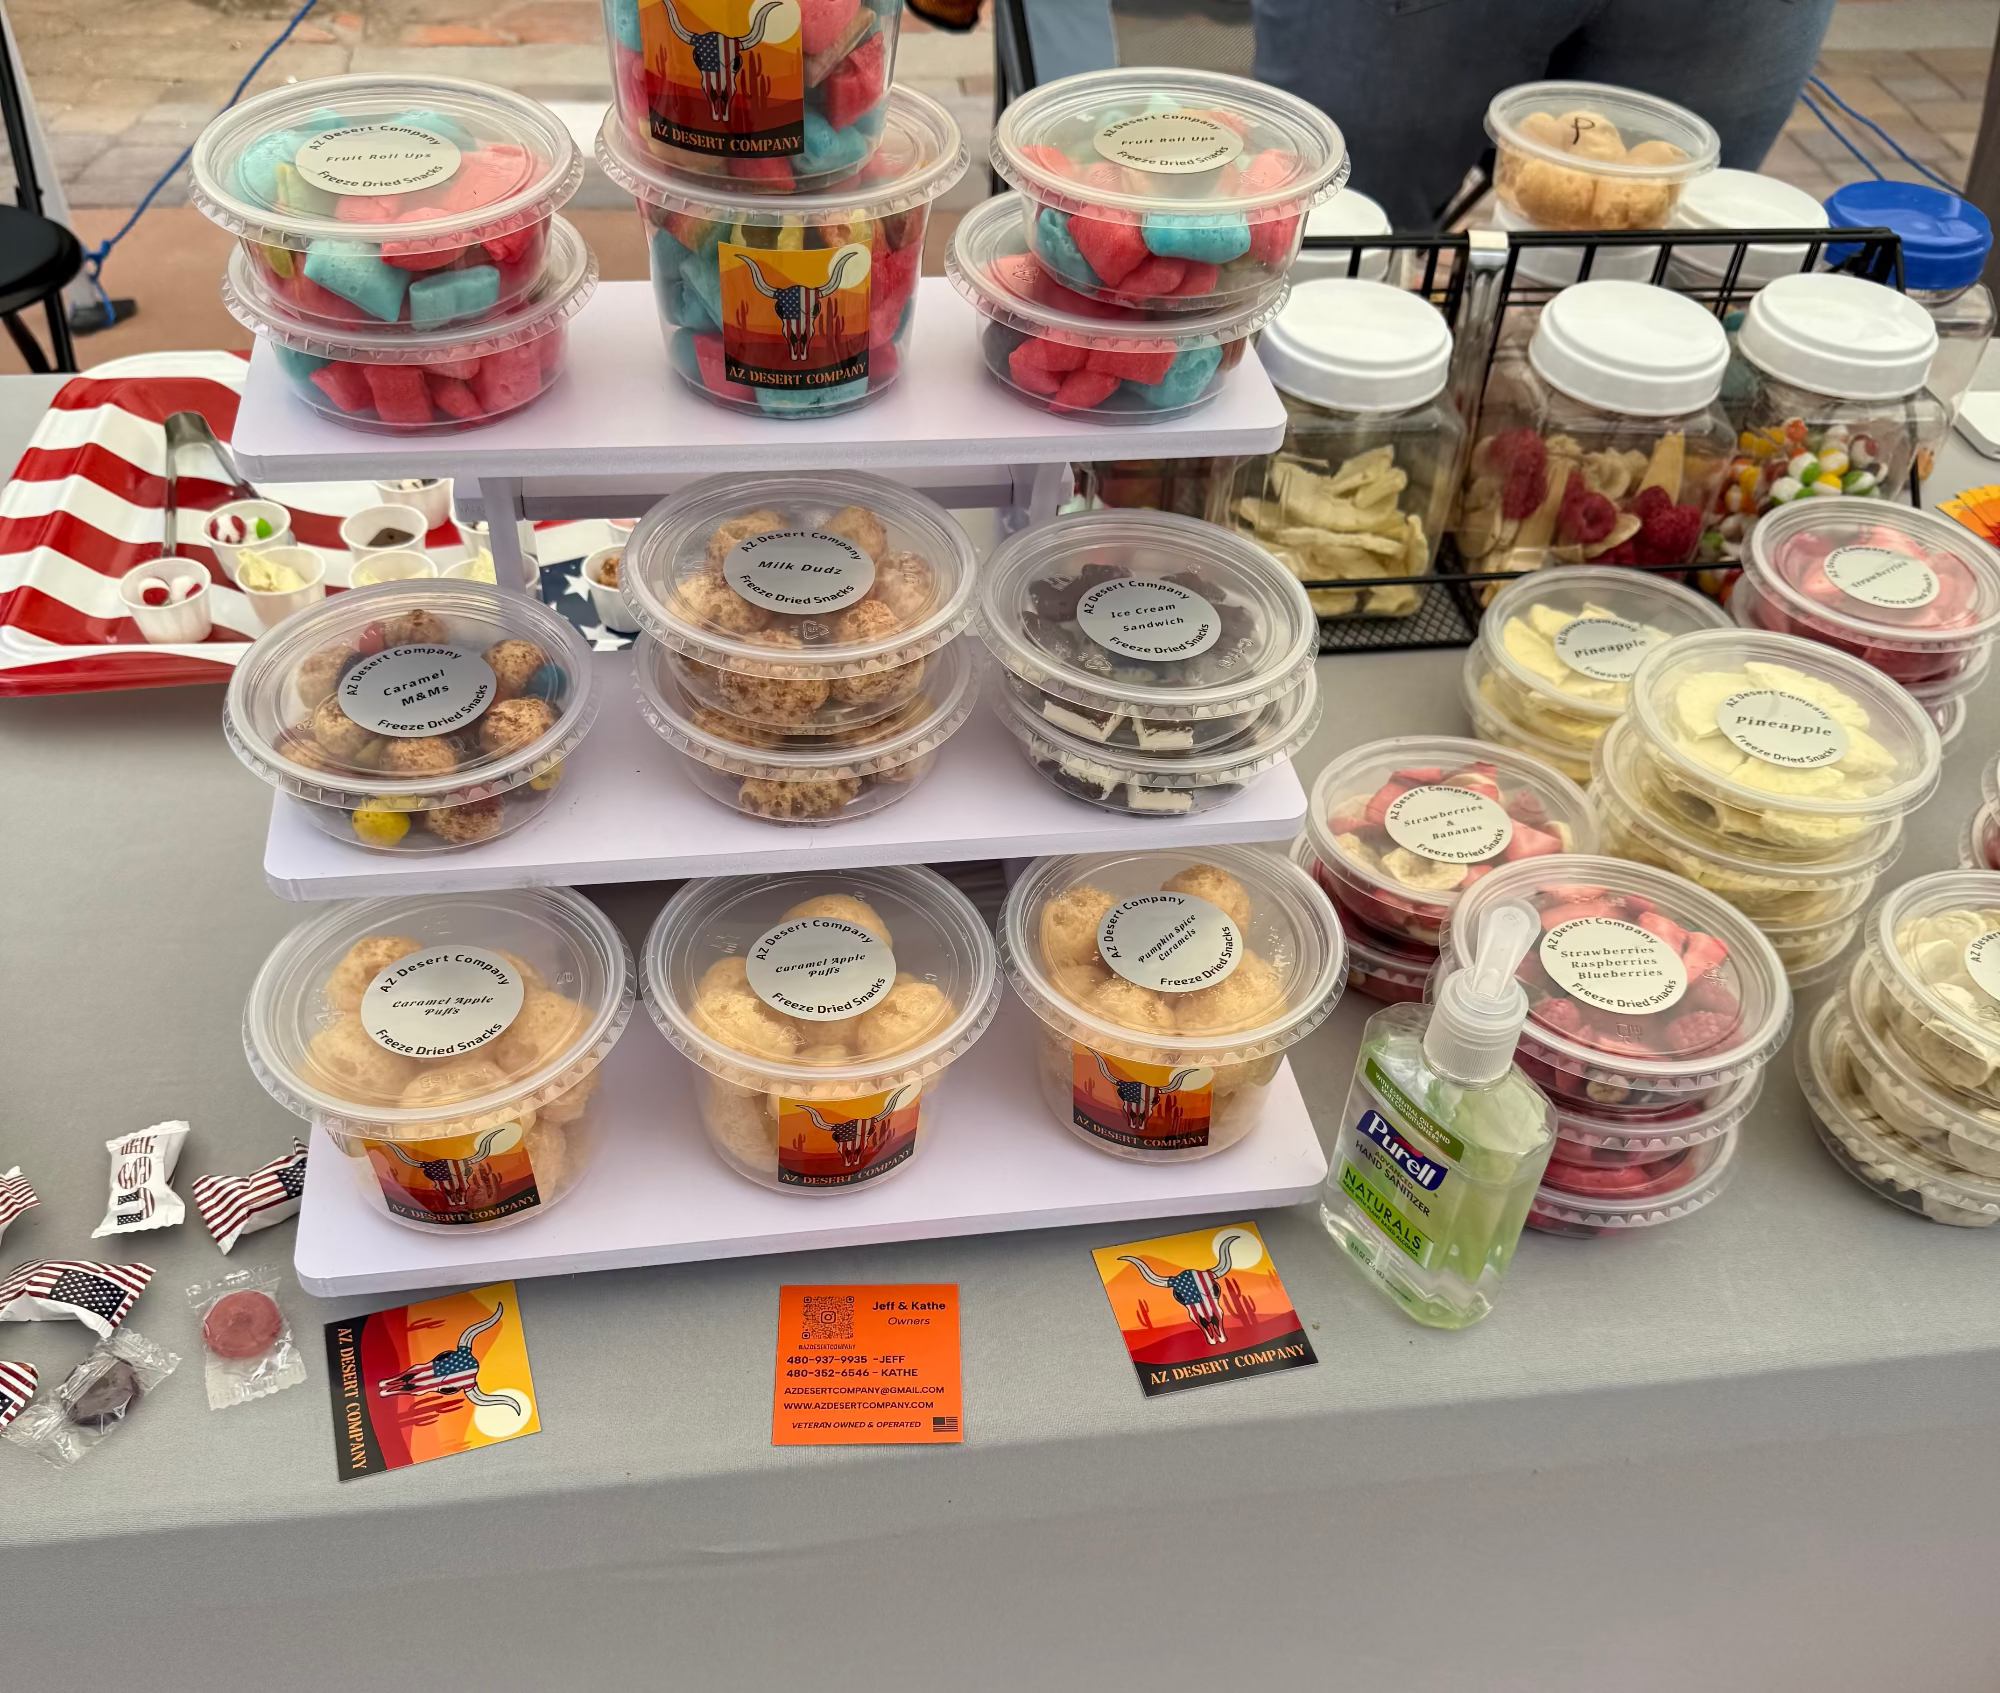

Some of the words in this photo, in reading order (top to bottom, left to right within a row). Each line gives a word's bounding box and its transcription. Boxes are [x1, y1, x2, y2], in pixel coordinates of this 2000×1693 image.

[653, 121, 669, 138] AZ
[672, 128, 725, 150] DESERT
[730, 136, 802, 152] COMPANY
[1103, 129, 1118, 138] AZ
[1113, 115, 1157, 130] Desert
[1162, 114, 1221, 131] Company
[1571, 116, 1595, 145] P
[309, 140, 326, 151] AZ
[323, 126, 375, 141] Desert
[380, 125, 442, 146] Company
[326, 155, 363, 163] Fruit
[369, 153, 399, 161] Roll
[1117, 151, 1156, 165] Freeze
[1160, 159, 1195, 167] Dried
[1196, 146, 1229, 164] Snacks
[317, 170, 360, 188] Freeze
[362, 179, 402, 188] Dried
[403, 165, 444, 185] Snacks
[730, 366, 746, 380] AZ
[750, 371, 802, 385] DESERT
[806, 362, 866, 385] COMPANY
[741, 541, 758, 553] AZ
[756, 532, 805, 544] Desert
[811, 532, 862, 561] Company
[758, 560, 795, 571] Milk
[800, 564, 843, 575] Dudz
[739, 574, 774, 599] Freeze
[775, 594, 811, 605] Dried
[814, 585, 855, 604] Snacks
[1088, 582, 1125, 603] Desert
[1128, 580, 1190, 601] Company
[1083, 602, 1095, 615] AZ
[1110, 611, 1131, 619] Ice
[1135, 603, 1177, 616] Cream
[1123, 616, 1184, 632] Sandwich
[1109, 636, 1152, 654] Freeze
[1154, 644, 1188, 655] Dried
[1185, 623, 1210, 648] Snacks
[1574, 640, 1647, 659] Pineapple
[394, 647, 463, 661] Company
[350, 654, 391, 682] Desert
[347, 684, 359, 696] AZ
[383, 668, 445, 697] Caramel
[400, 685, 450, 707] M&Ms
[1726, 698, 1739, 709] AZ
[1736, 690, 1776, 700] Desert
[1780, 691, 1832, 721] Company
[378, 720, 425, 731] Freeze
[428, 711, 464, 729] Dried
[460, 684, 488, 714] Snacks
[1736, 716, 1832, 737] Pineapple
[1736, 735, 1771, 757] Freeze
[1773, 753, 1805, 764] Dried
[1806, 747, 1837, 763] Snacks
[1394, 789, 1426, 809] Desert
[1428, 786, 1484, 801] Company
[1390, 810, 1400, 821] AZ
[1404, 805, 1484, 827] Strawberries
[1416, 843, 1454, 859] Freeze
[1456, 848, 1486, 859] Dried
[1484, 828, 1505, 851] Snacks
[1432, 825, 1483, 840] Bananas
[1122, 896, 1186, 911] Company
[1103, 910, 1125, 942] Desert
[1552, 918, 1592, 938] Desert
[1595, 917, 1658, 944] Company
[756, 947, 770, 961] AZ
[765, 922, 808, 947] Desert
[812, 920, 874, 945] Company
[1138, 931, 1175, 964] Pumpkin
[1174, 914, 1196, 935] Spice
[1158, 928, 1197, 962] Caramels
[1546, 938, 1559, 951] AZ
[1106, 945, 1123, 959] AZ
[1160, 976, 1203, 986] Freeze
[1201, 958, 1229, 980] Dried
[1222, 926, 1234, 959] Snacks
[1560, 946, 1655, 958] Strawberries
[1970, 950, 1982, 963] AZ
[380, 977, 398, 993] AZ
[396, 954, 450, 978] Desert
[454, 954, 510, 986] Company
[775, 958, 828, 973] Caramel
[831, 954, 866, 965] Apple
[808, 966, 841, 978] Puffs
[1571, 958, 1658, 969] Raspberries
[1578, 968, 1663, 980] Blueberries
[392, 996, 452, 1009] Caramel
[454, 996, 494, 1006] Apple
[772, 992, 814, 1013] Freeze
[817, 1002, 853, 1014] Dried
[852, 977, 886, 1007] Snacks
[1572, 982, 1614, 1006] Freeze
[1616, 999, 1651, 1008] Dried
[1650, 979, 1677, 1004] Snacks
[424, 1007, 461, 1017] Puffs
[375, 1028, 414, 1054] Freeze
[415, 1044, 455, 1056] Dried
[457, 1023, 503, 1051] Snacks
[1076, 1115, 1090, 1128] AZ
[1093, 1124, 1140, 1145] DESERT
[1143, 1136, 1206, 1147] COMPANY
[1420, 1116, 1434, 1132] OILS
[1435, 1132, 1451, 1145] AND
[1368, 1112, 1437, 1187] Purell
[782, 1174, 799, 1182] AZ
[803, 1174, 854, 1185] DESERT
[858, 1148, 910, 1179] COMPANY
[1374, 1151, 1414, 1190] ADVANCED
[1356, 1140, 1383, 1170] HAND
[1384, 1170, 1431, 1217] SANITIZER
[392, 1204, 406, 1214] AZ
[410, 1210, 467, 1222] DESERT
[469, 1194, 536, 1220] COMPANY
[1344, 1166, 1422, 1250] NATURALS
[1367, 1205, 1381, 1221] PLANT
[872, 1301, 895, 1311] Jeff
[898, 1302, 908, 1311] &
[911, 1301, 946, 1311] Kathe
[887, 1316, 931, 1326] Owners
[338, 1328, 353, 1345] AZ
[786, 1356, 868, 1364] 480-937-9935
[1150, 1370, 1170, 1385] AZ
[1172, 1358, 1230, 1381] DESERT
[1234, 1344, 1305, 1369] COMPANY
[340, 1346, 359, 1398] DESERT
[786, 1369, 870, 1378] 480-352-6546
[881, 1369, 918, 1377] KATHE
[784, 1386, 945, 1396] AZDESERTCOMPANY@GMAIL.COM
[784, 1402, 934, 1410] WWW.AZDESERTCOMPANY.COM
[346, 1402, 367, 1469] COMPANY
